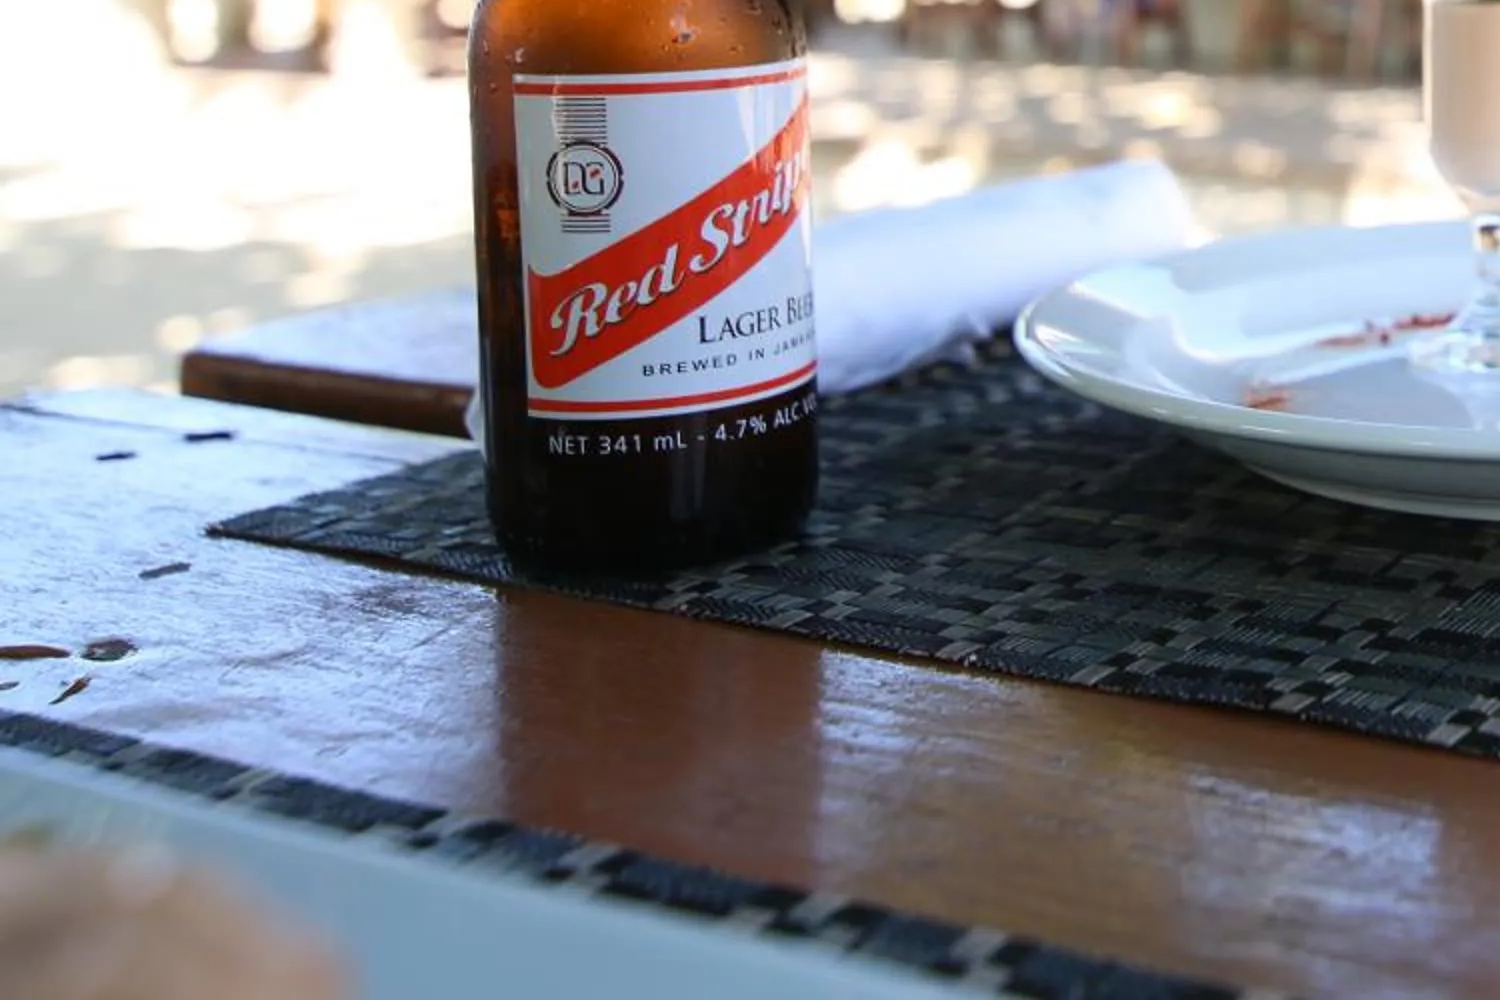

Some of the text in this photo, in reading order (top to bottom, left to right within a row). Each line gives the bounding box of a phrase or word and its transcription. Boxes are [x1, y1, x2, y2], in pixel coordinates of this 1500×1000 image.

[549, 151, 801, 357] Red Strip
[698, 305, 782, 345] LAGER
[642, 353, 738, 377] BREWED
[748, 347, 765, 361] IN
[549, 434, 589, 456] NET
[599, 434, 642, 455] 341
[653, 430, 688, 451] mL
[714, 413, 768, 441] 4.7%
